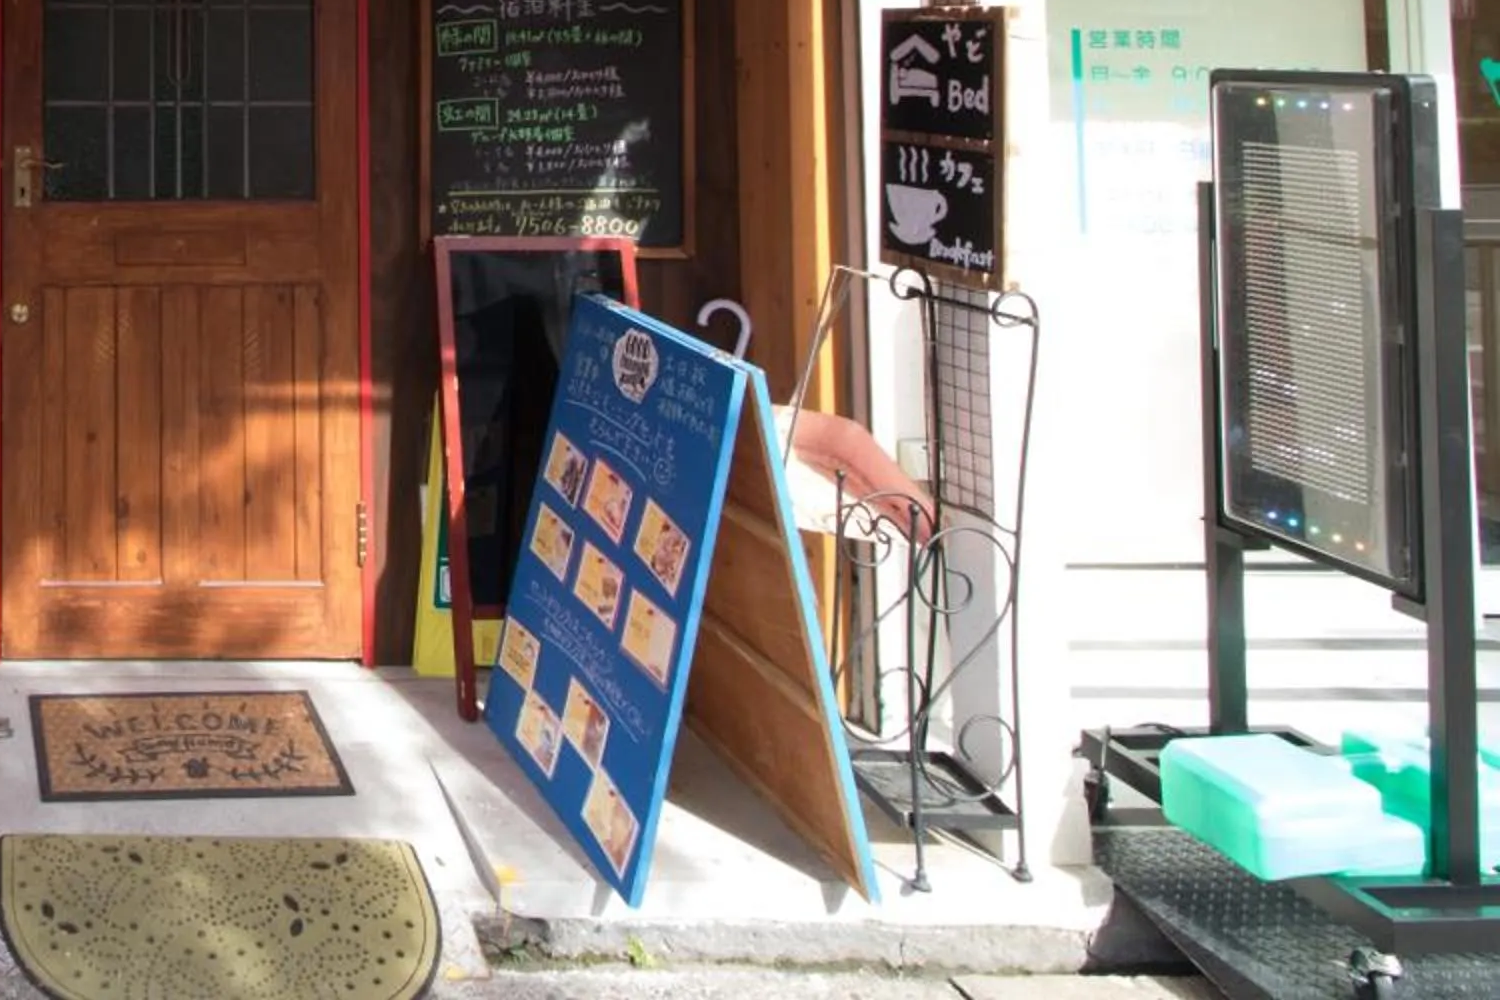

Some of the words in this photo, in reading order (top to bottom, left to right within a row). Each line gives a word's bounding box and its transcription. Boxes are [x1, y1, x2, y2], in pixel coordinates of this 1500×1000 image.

[941, 23, 987, 63] やど
[1088, 29, 1181, 49] 営業時間
[947, 74, 989, 114] Bed
[940, 151, 985, 194] カフェ
[82, 710, 287, 739] WELCOME
